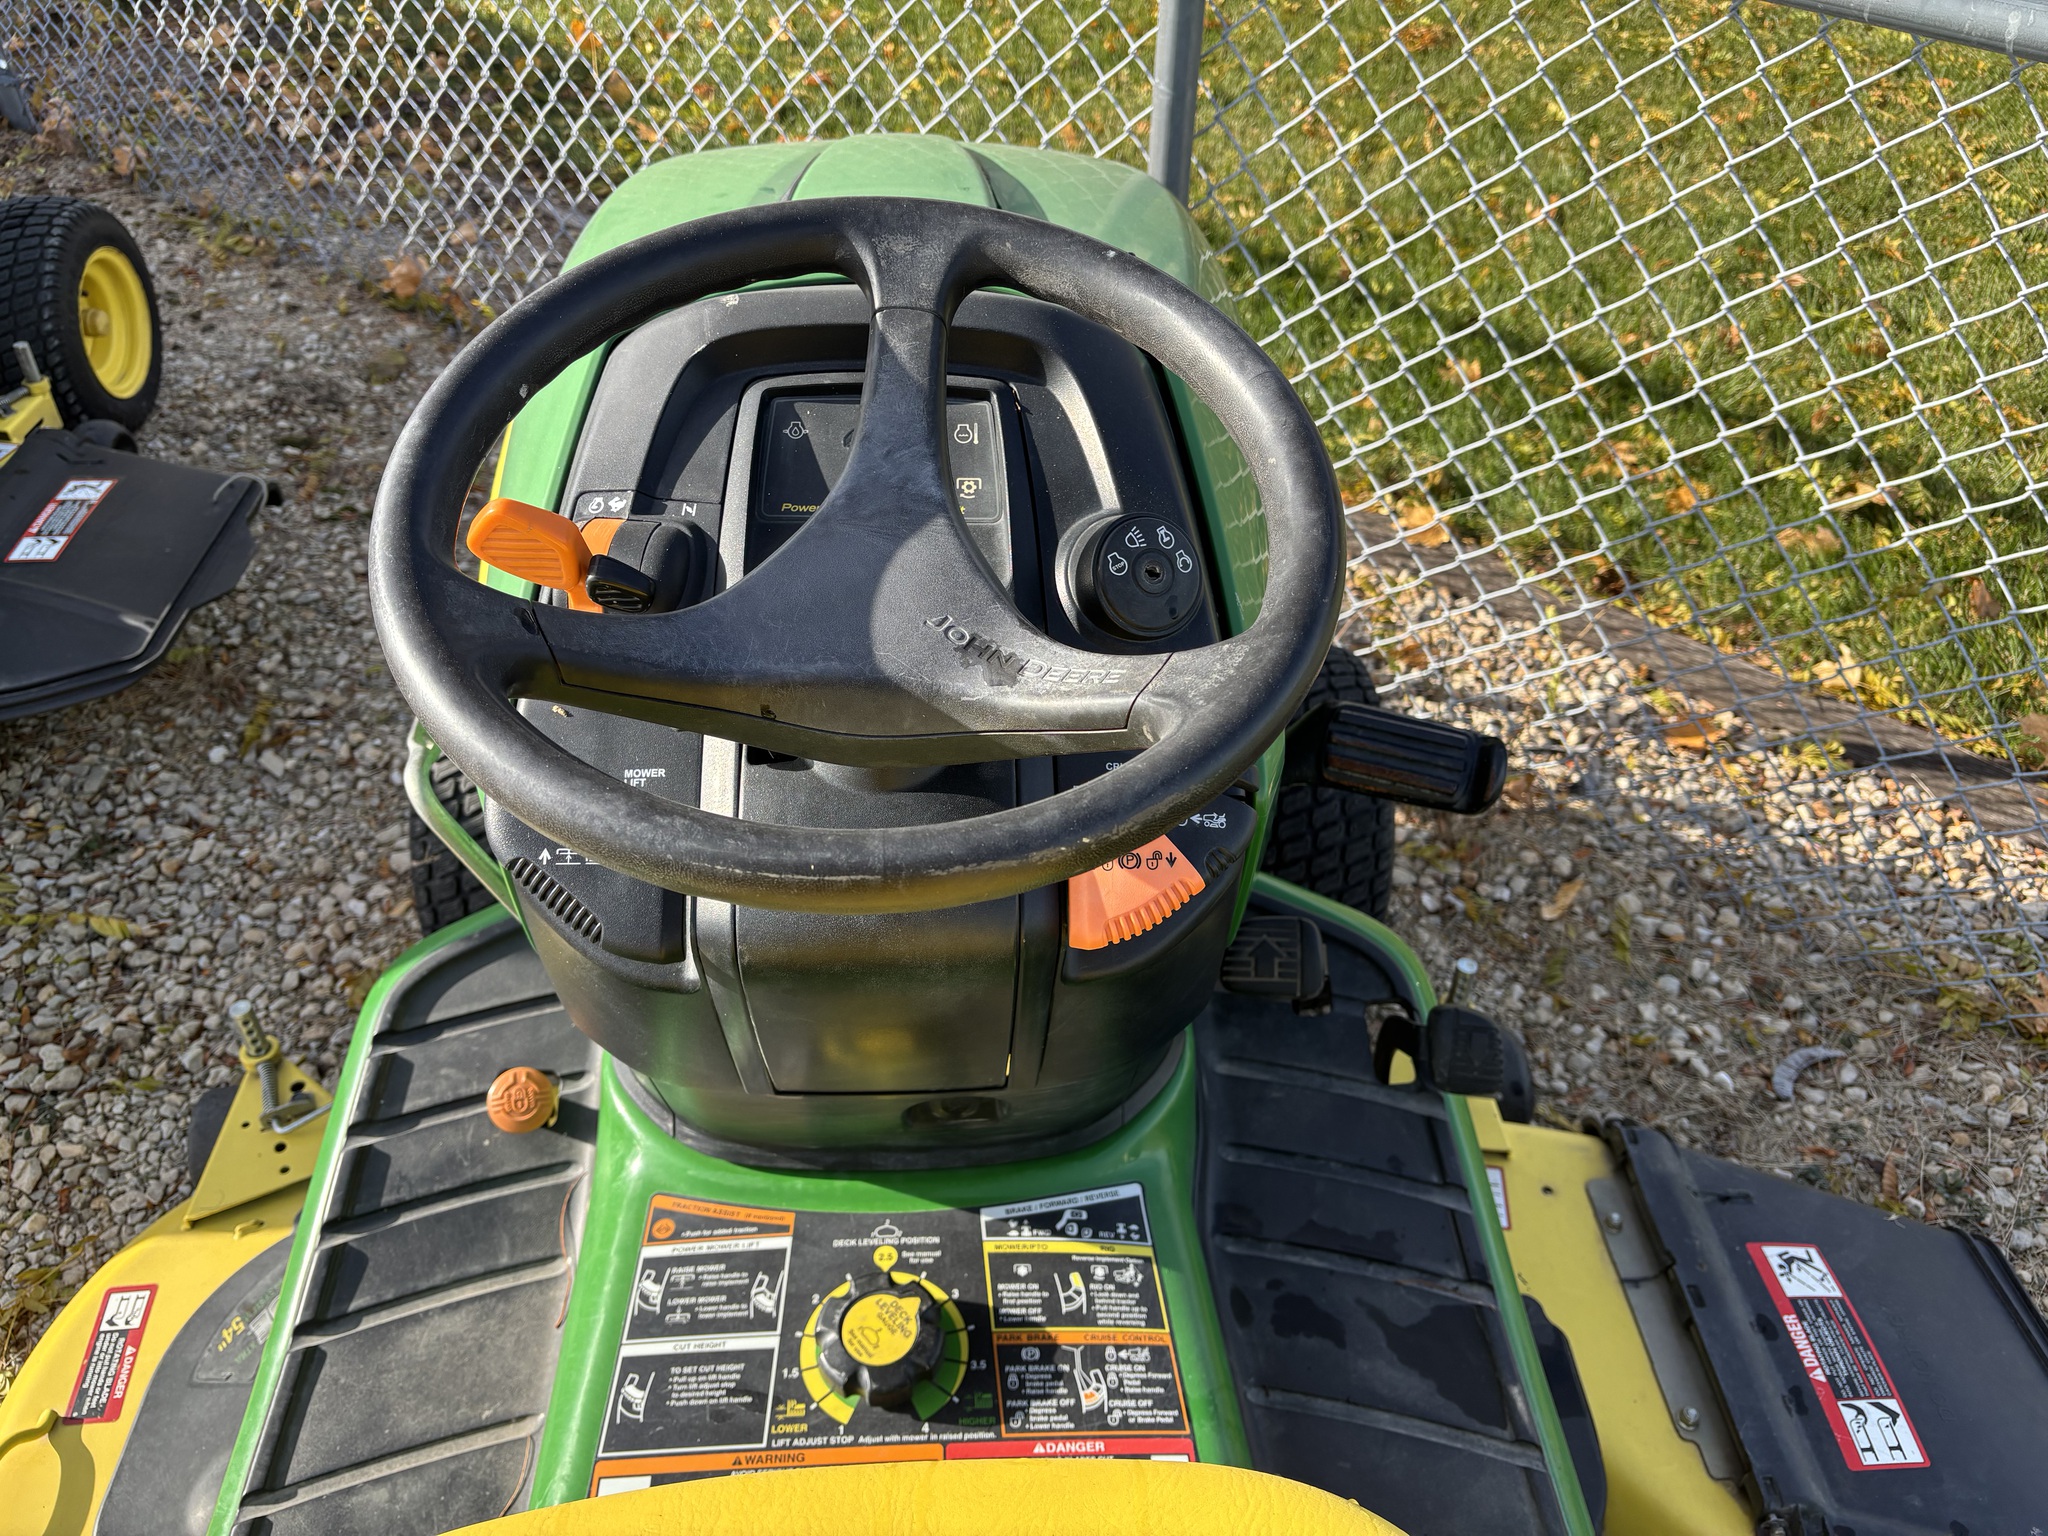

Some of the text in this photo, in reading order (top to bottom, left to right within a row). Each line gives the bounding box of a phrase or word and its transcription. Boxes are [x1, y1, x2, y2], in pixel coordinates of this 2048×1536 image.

[924, 614, 1126, 684] JOHN DEERE
[624, 768, 666, 778] MOWER
[833, 1238, 857, 1248] DECK
[878, 1253, 893, 1261] 2.5
[812, 1293, 820, 1305] 2
[952, 1288, 959, 1300] 3
[890, 1300, 912, 1325] DECK
[218, 1316, 245, 1352] 54"
[1782, 1314, 1820, 1367] DANGER
[108, 1337, 126, 1376] ROTATING
[970, 1360, 987, 1370] 3.5
[113, 1356, 134, 1399] DANGER
[782, 1367, 799, 1379] 1.5
[958, 1416, 996, 1426] HIGHER
[771, 1423, 808, 1434] LOWER
[838, 1425, 844, 1435] 1
[921, 1422, 930, 1433] 4
[771, 1439, 792, 1448] LIFT
[792, 1437, 828, 1447] ADJUST
[830, 1435, 854, 1445] STOP
[858, 1435, 883, 1445] Adjust
[888, 1433, 901, 1442] with
[902, 1434, 928, 1442] mower
[930, 1431, 938, 1441] in
[939, 1431, 962, 1441] raised
[1046, 1441, 1105, 1453] DANGER
[745, 1452, 805, 1465] WARNING
